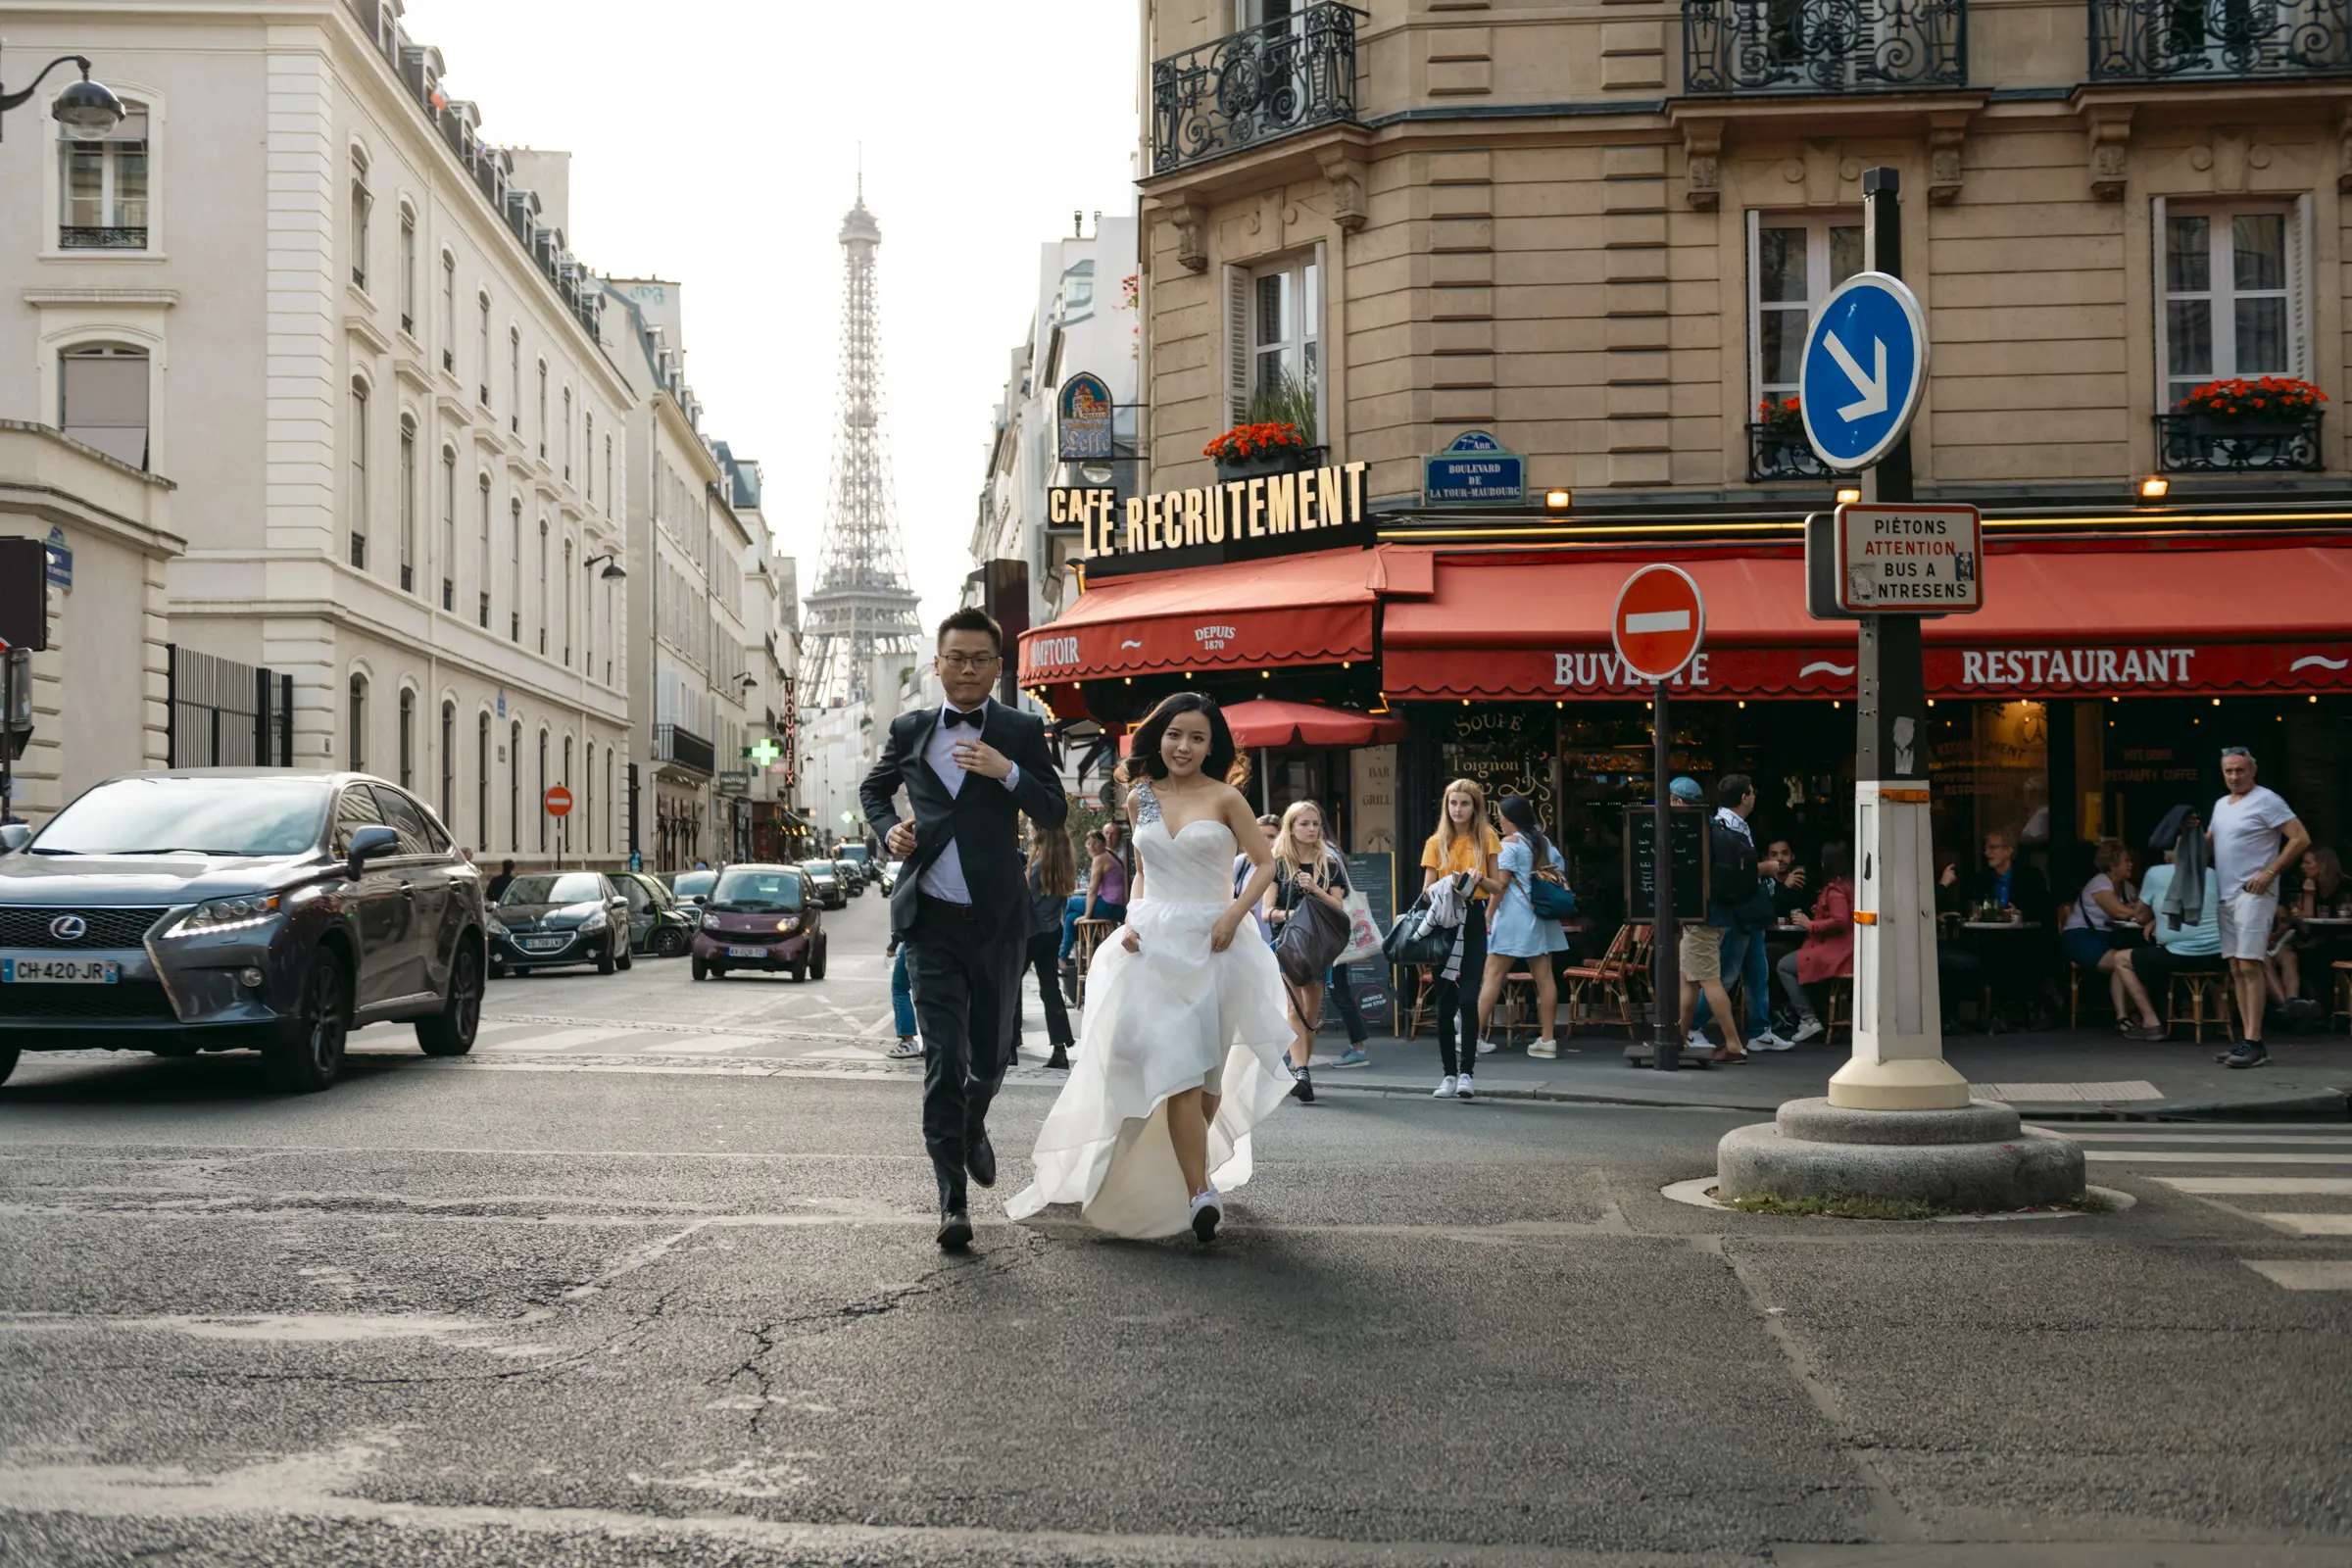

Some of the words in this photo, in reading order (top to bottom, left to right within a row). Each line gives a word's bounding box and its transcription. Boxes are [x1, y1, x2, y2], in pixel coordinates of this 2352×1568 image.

[1448, 464, 1501, 474] BOULEVARD
[1468, 475, 1482, 486] DE
[1429, 489, 1443, 499] LA
[1443, 486, 1520, 498] TOUR-MAUBOURG
[1083, 501, 1115, 558] LE
[1126, 461, 1365, 554] RECRUTEMENT
[1874, 516, 1946, 535] PIÉTONS
[1864, 540, 1956, 556] ATTENTION
[1885, 562, 1918, 577] BUS
[1926, 562, 1936, 577] A
[1878, 583, 1967, 599] NTRESENS
[1194, 625, 1236, 642] DEPUIS
[1203, 640, 1225, 651] 1870
[1553, 653, 1709, 685] BUVEE
[1962, 648, 2195, 684] RESTAURANT
[784, 679, 795, 785] THOUMIEUX
[1368, 766, 1390, 778] BAR
[1362, 794, 1393, 807] GRILL
[17, 961, 104, 980] CH-420-JR
